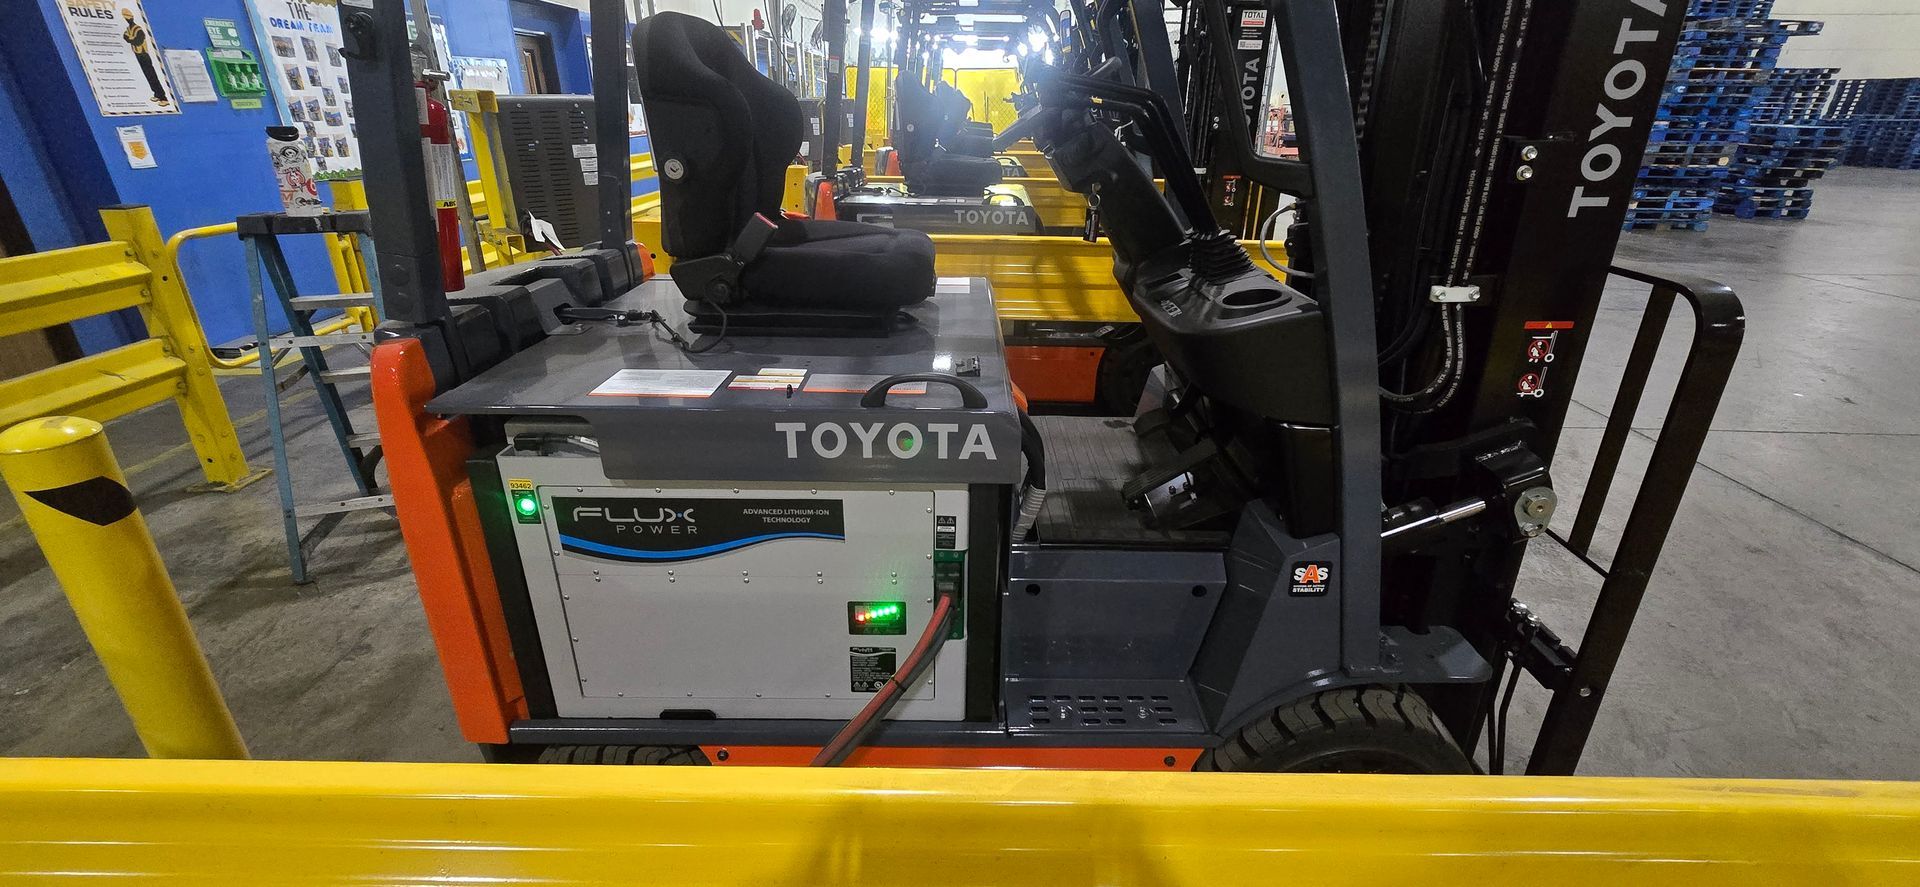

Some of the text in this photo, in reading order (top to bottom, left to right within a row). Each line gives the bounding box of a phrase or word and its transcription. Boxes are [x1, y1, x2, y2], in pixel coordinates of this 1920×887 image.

[68, 6, 114, 20] RULES
[286, 2, 312, 21] THE
[1243, 11, 1265, 19] TOTAL
[269, 17, 334, 34] DREAM TEAM
[954, 209, 1029, 226] TOYOTA
[775, 421, 998, 460] TOYOTA
[572, 506, 696, 523] FLUX
[616, 524, 698, 534] POWER
[1293, 564, 1329, 583] SAS
